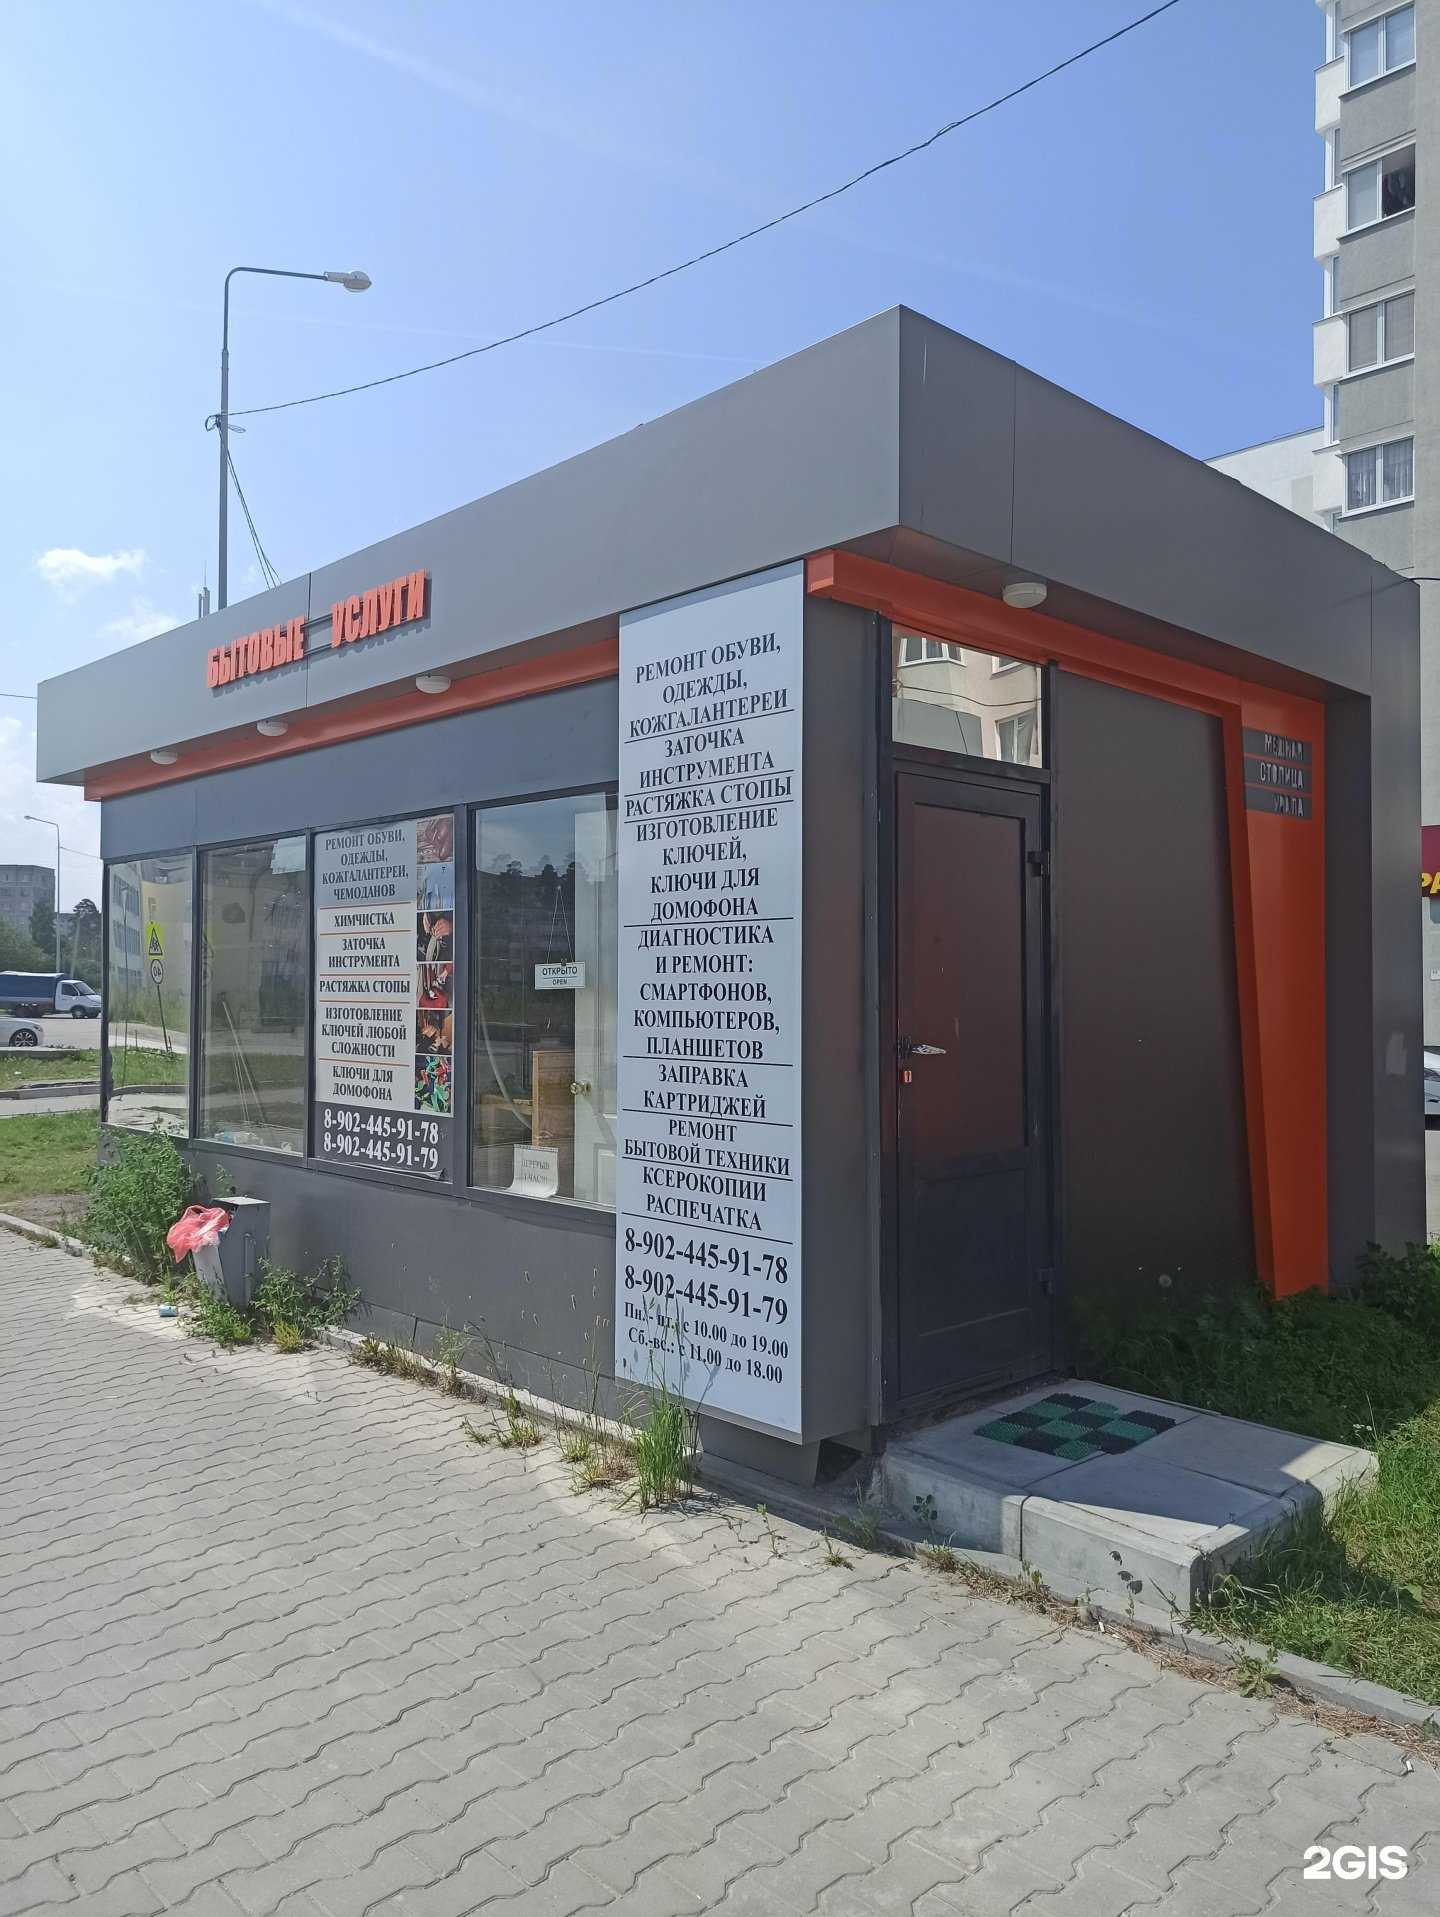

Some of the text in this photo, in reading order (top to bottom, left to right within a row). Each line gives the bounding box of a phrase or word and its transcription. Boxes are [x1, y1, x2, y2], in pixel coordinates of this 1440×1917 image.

[206, 568, 428, 688] БЫТОВЫЕ УСЛУГИ
[636, 632, 781, 684] РЕМОНТ ОБУВИ,
[662, 669, 747, 704] ОДЕЖДЫ,
[630, 688, 788, 738] КОЖГАЛАНТЕРЕИ
[665, 727, 744, 758] ЗАТОЧКА
[640, 751, 774, 789] ИНСТРУМЕНТА
[1260, 762, 1304, 789] СТОЛИЦА
[626, 776, 791, 817] РАСТЯЖКА СТОПЫ
[637, 808, 778, 842] ИЗГОТОВЛЕНИЕ
[325, 832, 365, 850] РЕМОНТ
[663, 837, 747, 866] КЛЮЧЕЙ,
[341, 849, 388, 866] ОДЕЖДЫ,
[322, 865, 409, 885] КОЖГАЛАНТЕРЕИ,
[651, 867, 760, 893] КЛЮЧИ ДЛЯ
[334, 884, 395, 901] ЧЕМОДАНОВ
[334, 912, 394, 927] ХИМЧИСТКА
[651, 897, 758, 922] ДОМОФОНА
[342, 937, 386, 951] ЗАТОЧКА
[638, 925, 774, 950] ДИАГНОСТИКА
[328, 955, 400, 969] ИНСТРУМЕНТА
[542, 966, 577, 976] ОТКРЫТО
[656, 954, 753, 974] И РЕМОНТ:
[319, 980, 410, 993] РАСТЯЖКА СТОПЫ
[640, 982, 772, 1004] СМАРТФОНОВ,
[326, 1007, 402, 1022] ИЗГОТОВЛЕНИЕ
[634, 1010, 780, 1035] КОМПЬЮТЕРОВ,
[321, 1023, 407, 1040] КЛЮЧЕЙ ЛЮБОЙ
[332, 1041, 395, 1057] СЛОЖНОСТИ
[647, 1037, 763, 1059] ПЛАНШЕТОВ
[333, 1065, 393, 1083] КЛЮЧИ ДЛЯ
[658, 1064, 748, 1088] ЗАПРАВКА
[333, 1083, 392, 1100] ДОМОФОНА
[644, 1090, 766, 1118] КАРТРИДЖЕЙ
[324, 1108, 439, 1144] 8-902-445-91-78
[669, 1119, 737, 1142] РЕМОНТ
[323, 1131, 438, 1169] 8-902-445-91-79
[625, 1139, 790, 1176] БЫТОВОЙ ТЕХНИКИ
[643, 1166, 767, 1201] КСЕРОКОПИИ
[647, 1194, 762, 1230] РАСПЕЧАТКА
[625, 1227, 788, 1284] 8-902-445-91-78
[625, 1265, 788, 1325] 8-902-445-91-79
[695, 1320, 727, 1343] 10.00
[731, 1333, 747, 1349] до
[752, 1335, 788, 1358] 19.00
[690, 1343, 722, 1367] 11.00
[725, 1358, 741, 1372] до
[747, 1359, 782, 1383] 18.00
